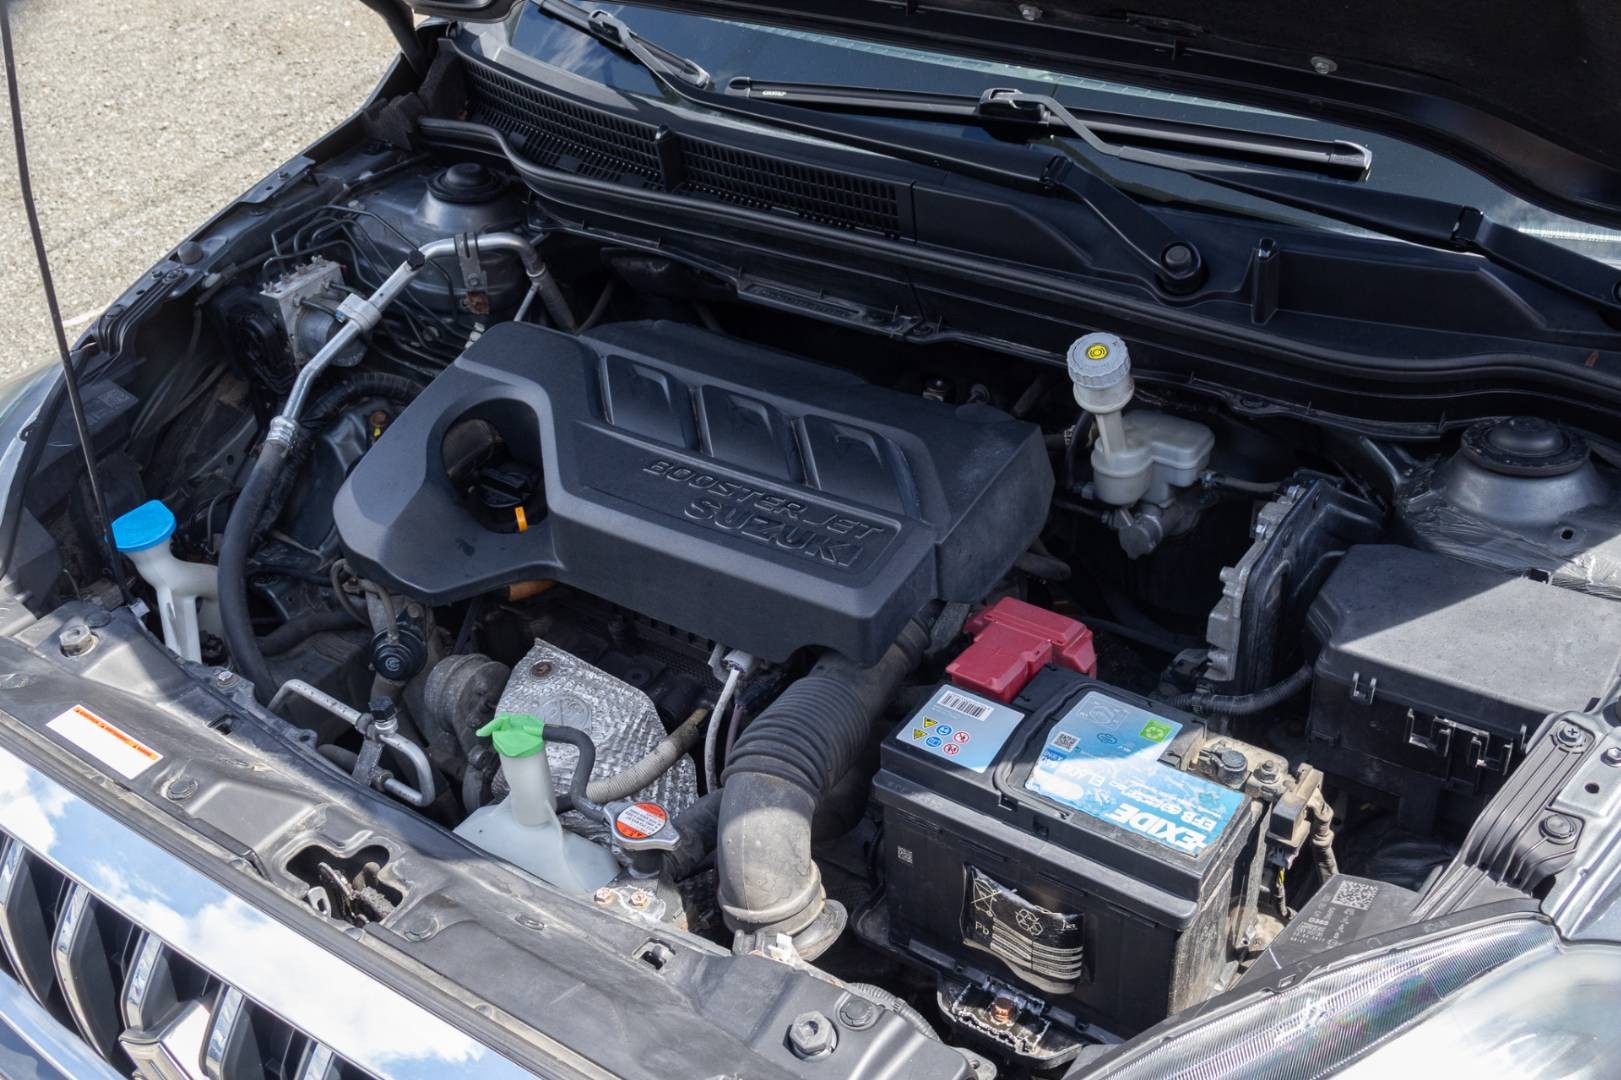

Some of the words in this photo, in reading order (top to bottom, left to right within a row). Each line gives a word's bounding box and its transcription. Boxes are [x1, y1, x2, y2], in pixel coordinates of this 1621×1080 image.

[642, 460, 808, 519] BOOSTER
[803, 514, 884, 539] JET
[683, 497, 865, 567] SUZUKI
[1107, 803, 1207, 854] EXIDE
[1180, 811, 1217, 832] EFB
[975, 921, 990, 936] Pb
